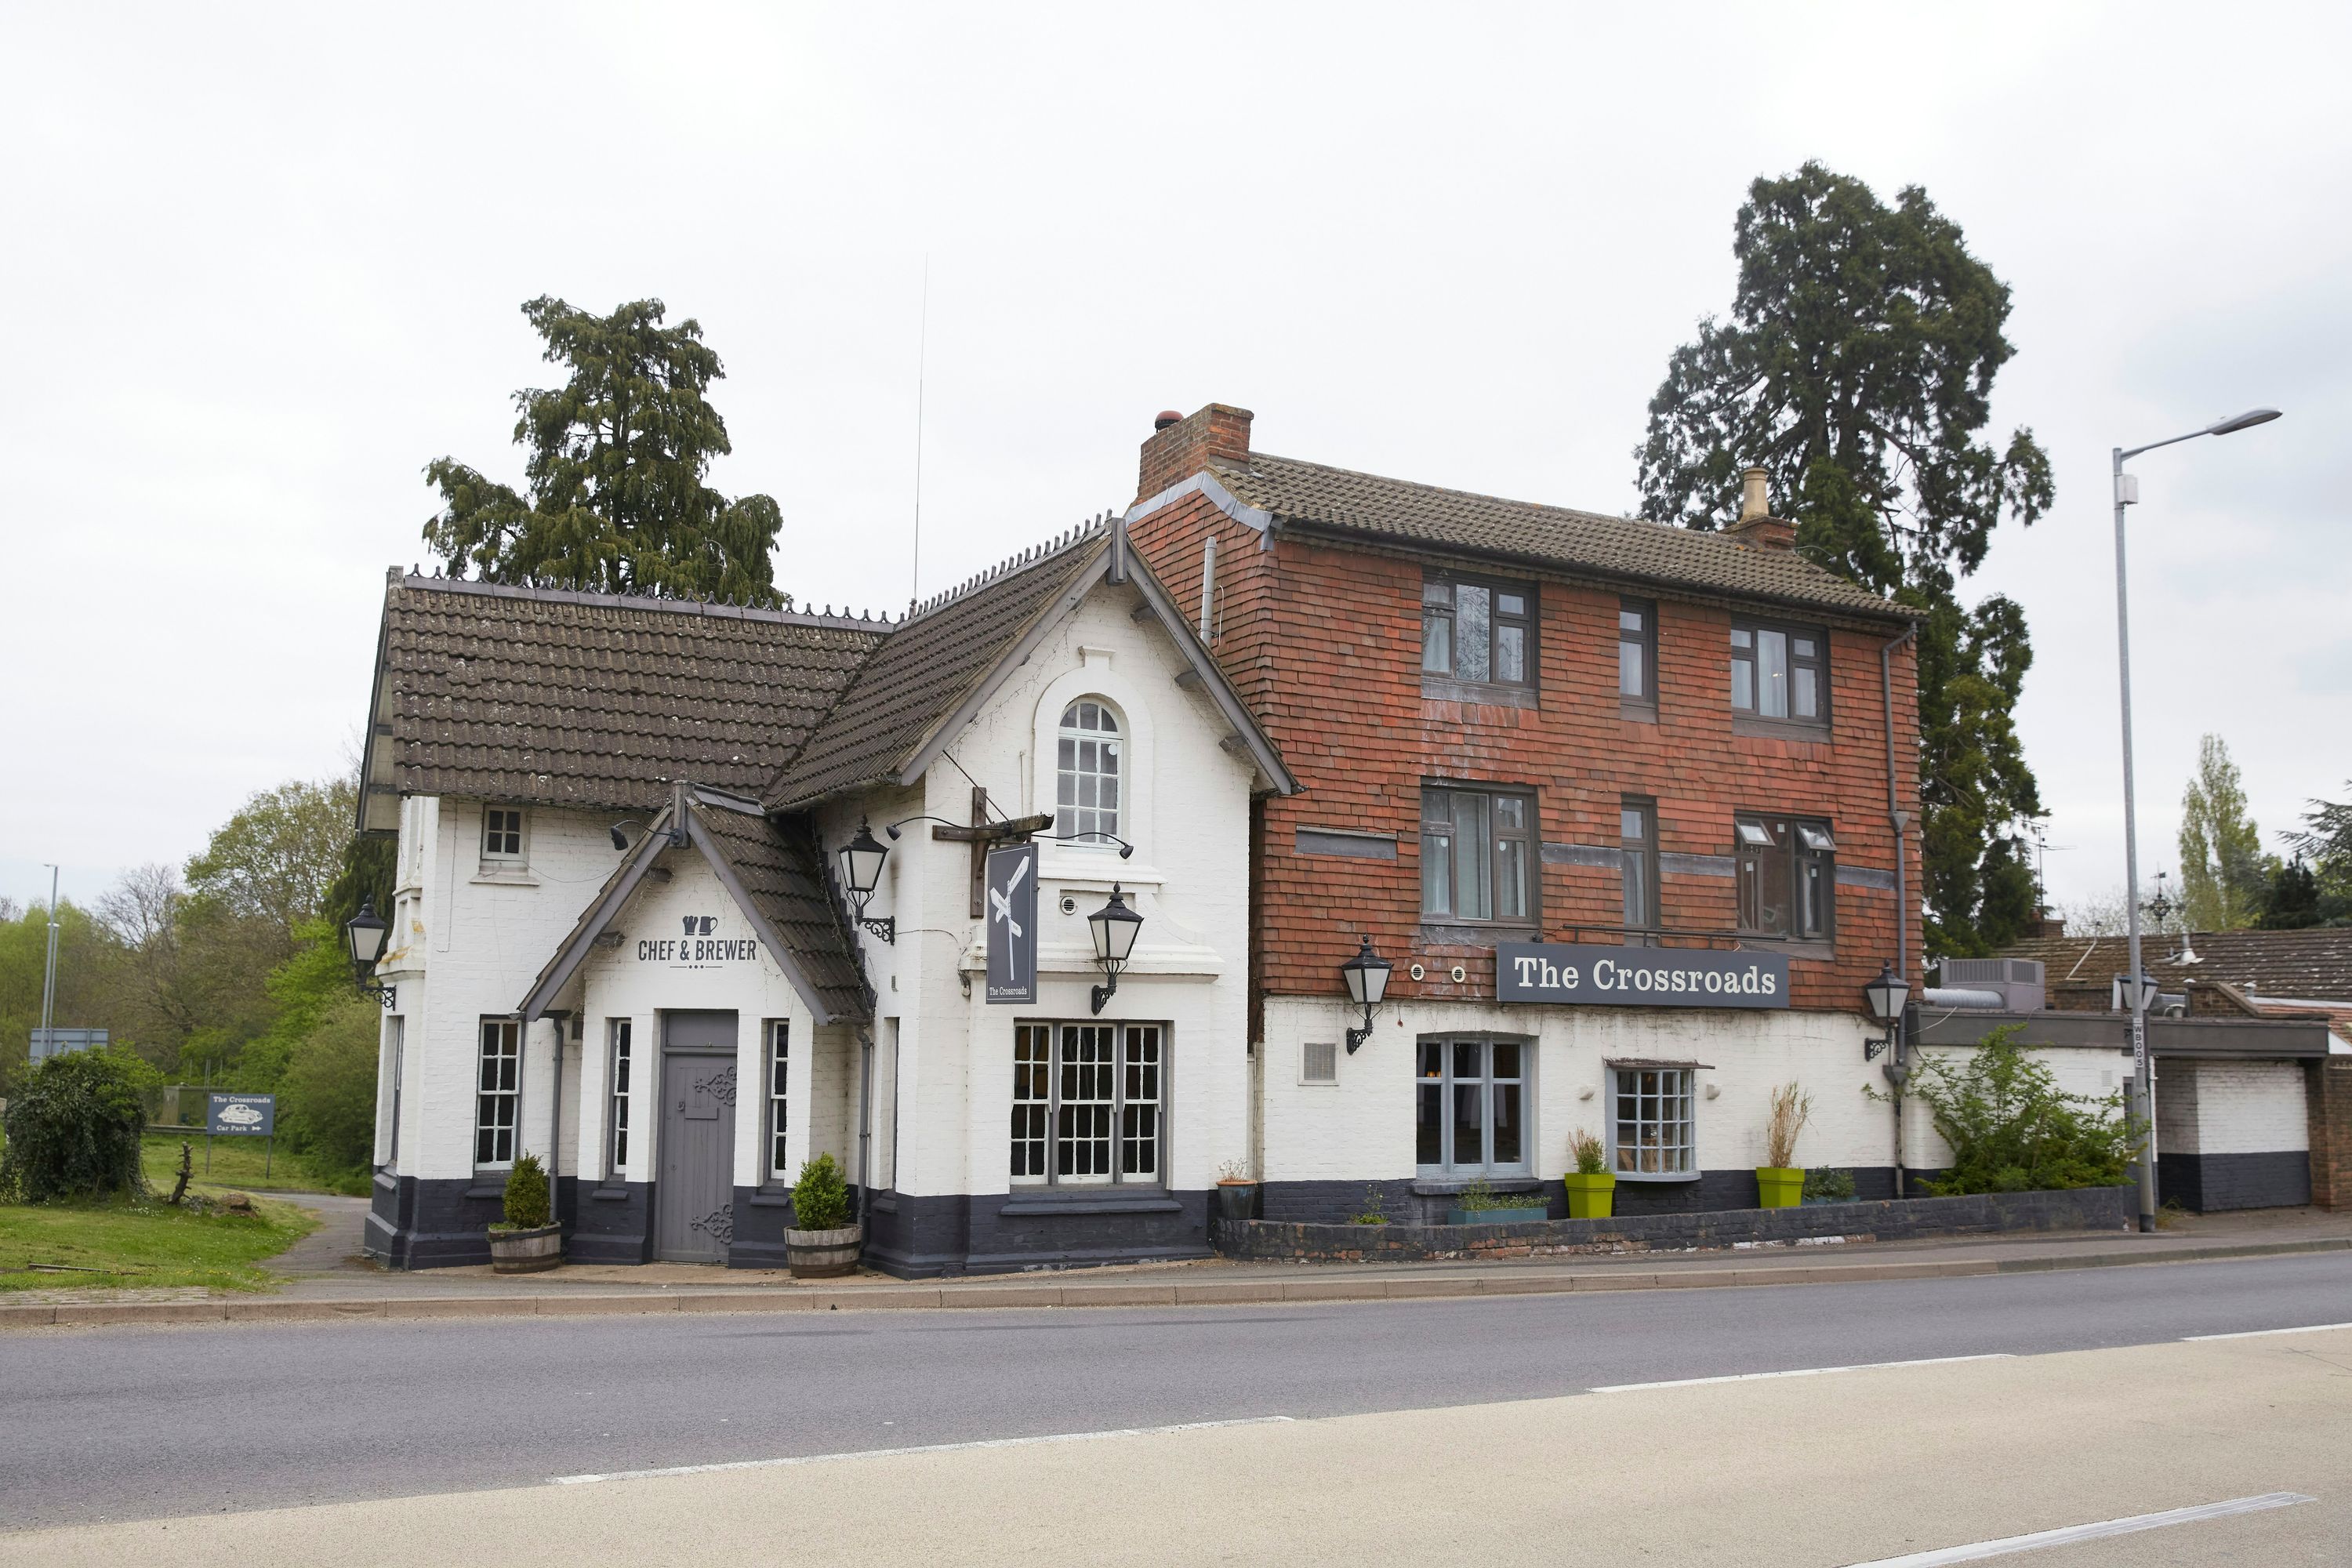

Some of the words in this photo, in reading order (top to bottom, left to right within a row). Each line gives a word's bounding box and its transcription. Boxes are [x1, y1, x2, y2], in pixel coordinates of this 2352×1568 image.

[638, 939, 676, 961] CHEF
[679, 939, 690, 961] &
[695, 939, 757, 960] BREWER
[1514, 956, 1579, 989] The
[1592, 959, 1777, 995] Crossroads
[989, 986, 999, 996] The
[999, 985, 1028, 996] Crossroads
